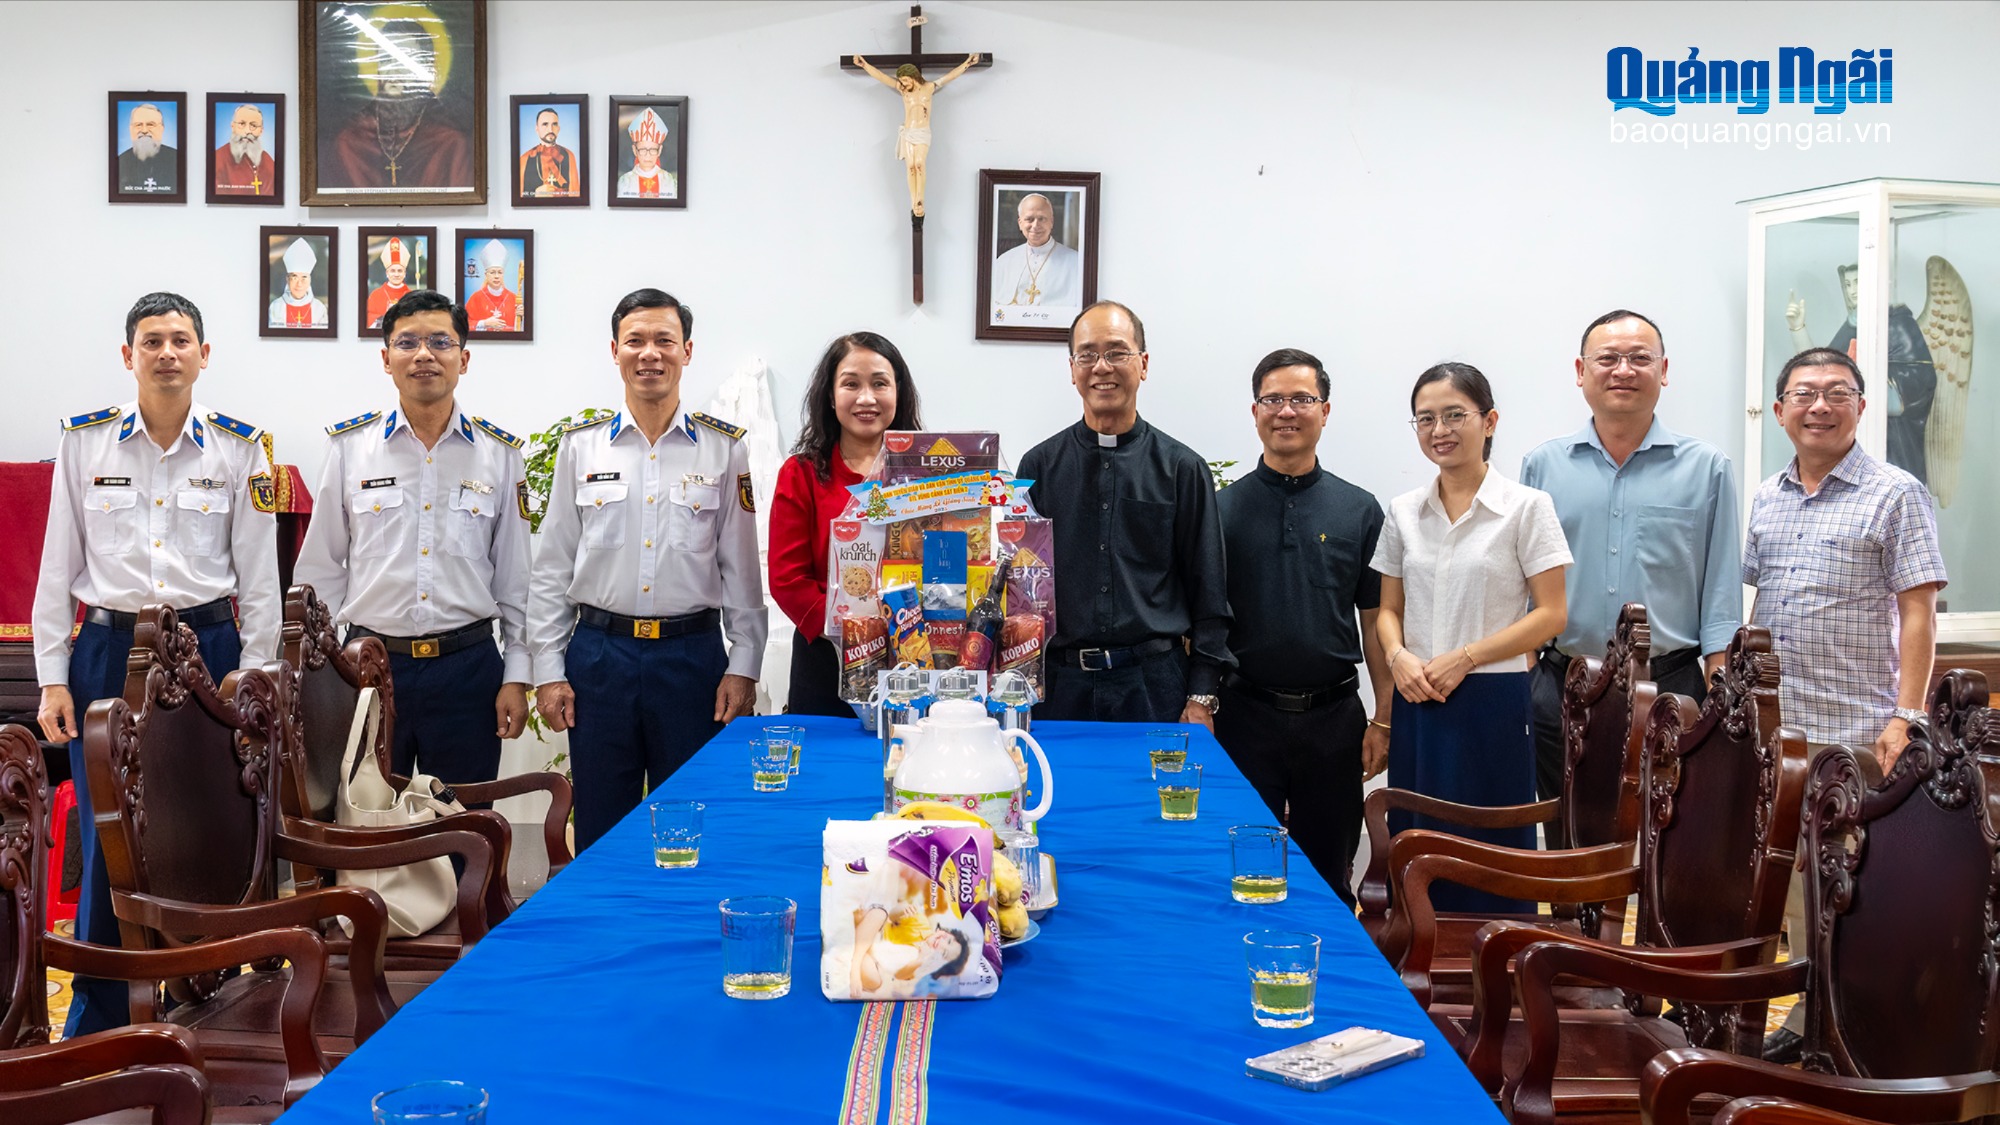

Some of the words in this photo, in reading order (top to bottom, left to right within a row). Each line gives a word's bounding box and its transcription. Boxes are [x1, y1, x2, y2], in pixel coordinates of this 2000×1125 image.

[921, 456, 966, 468] LEXUS
[851, 541, 871, 553] oat
[891, 530, 901, 556] KING
[840, 547, 877, 562] krunch
[846, 635, 886, 661] KOPIKO
[1001, 637, 1040, 662] KOPIKO
